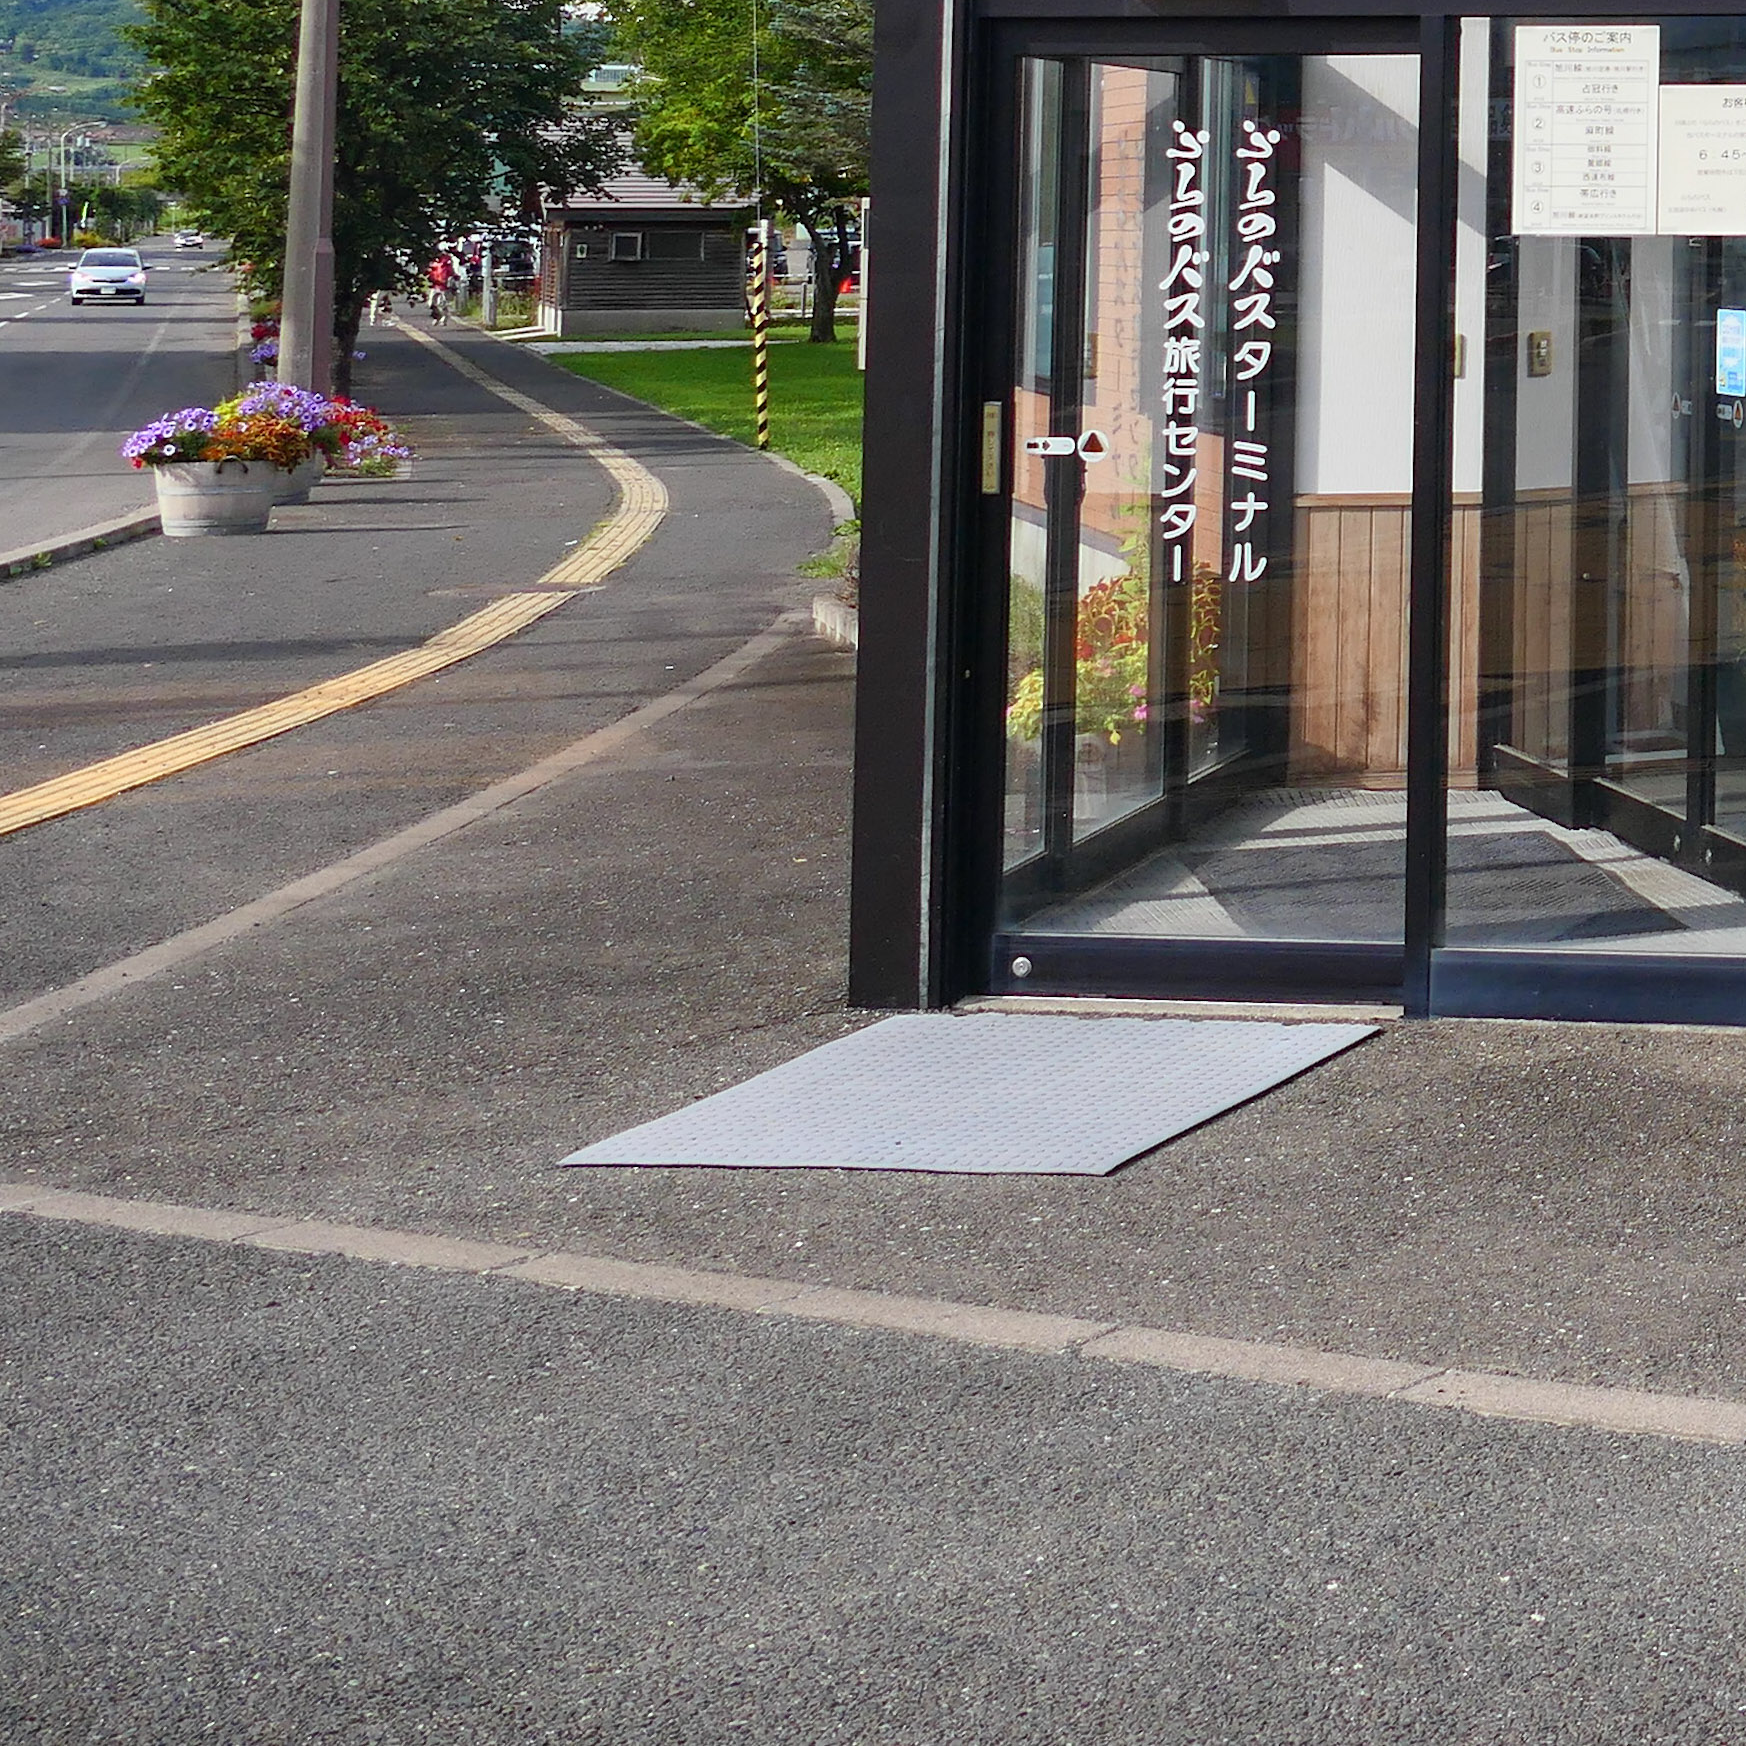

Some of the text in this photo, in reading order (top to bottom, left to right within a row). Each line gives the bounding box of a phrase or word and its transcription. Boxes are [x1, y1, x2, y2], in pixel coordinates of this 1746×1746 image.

[1543, 31, 1632, 44] バス停のご案内
